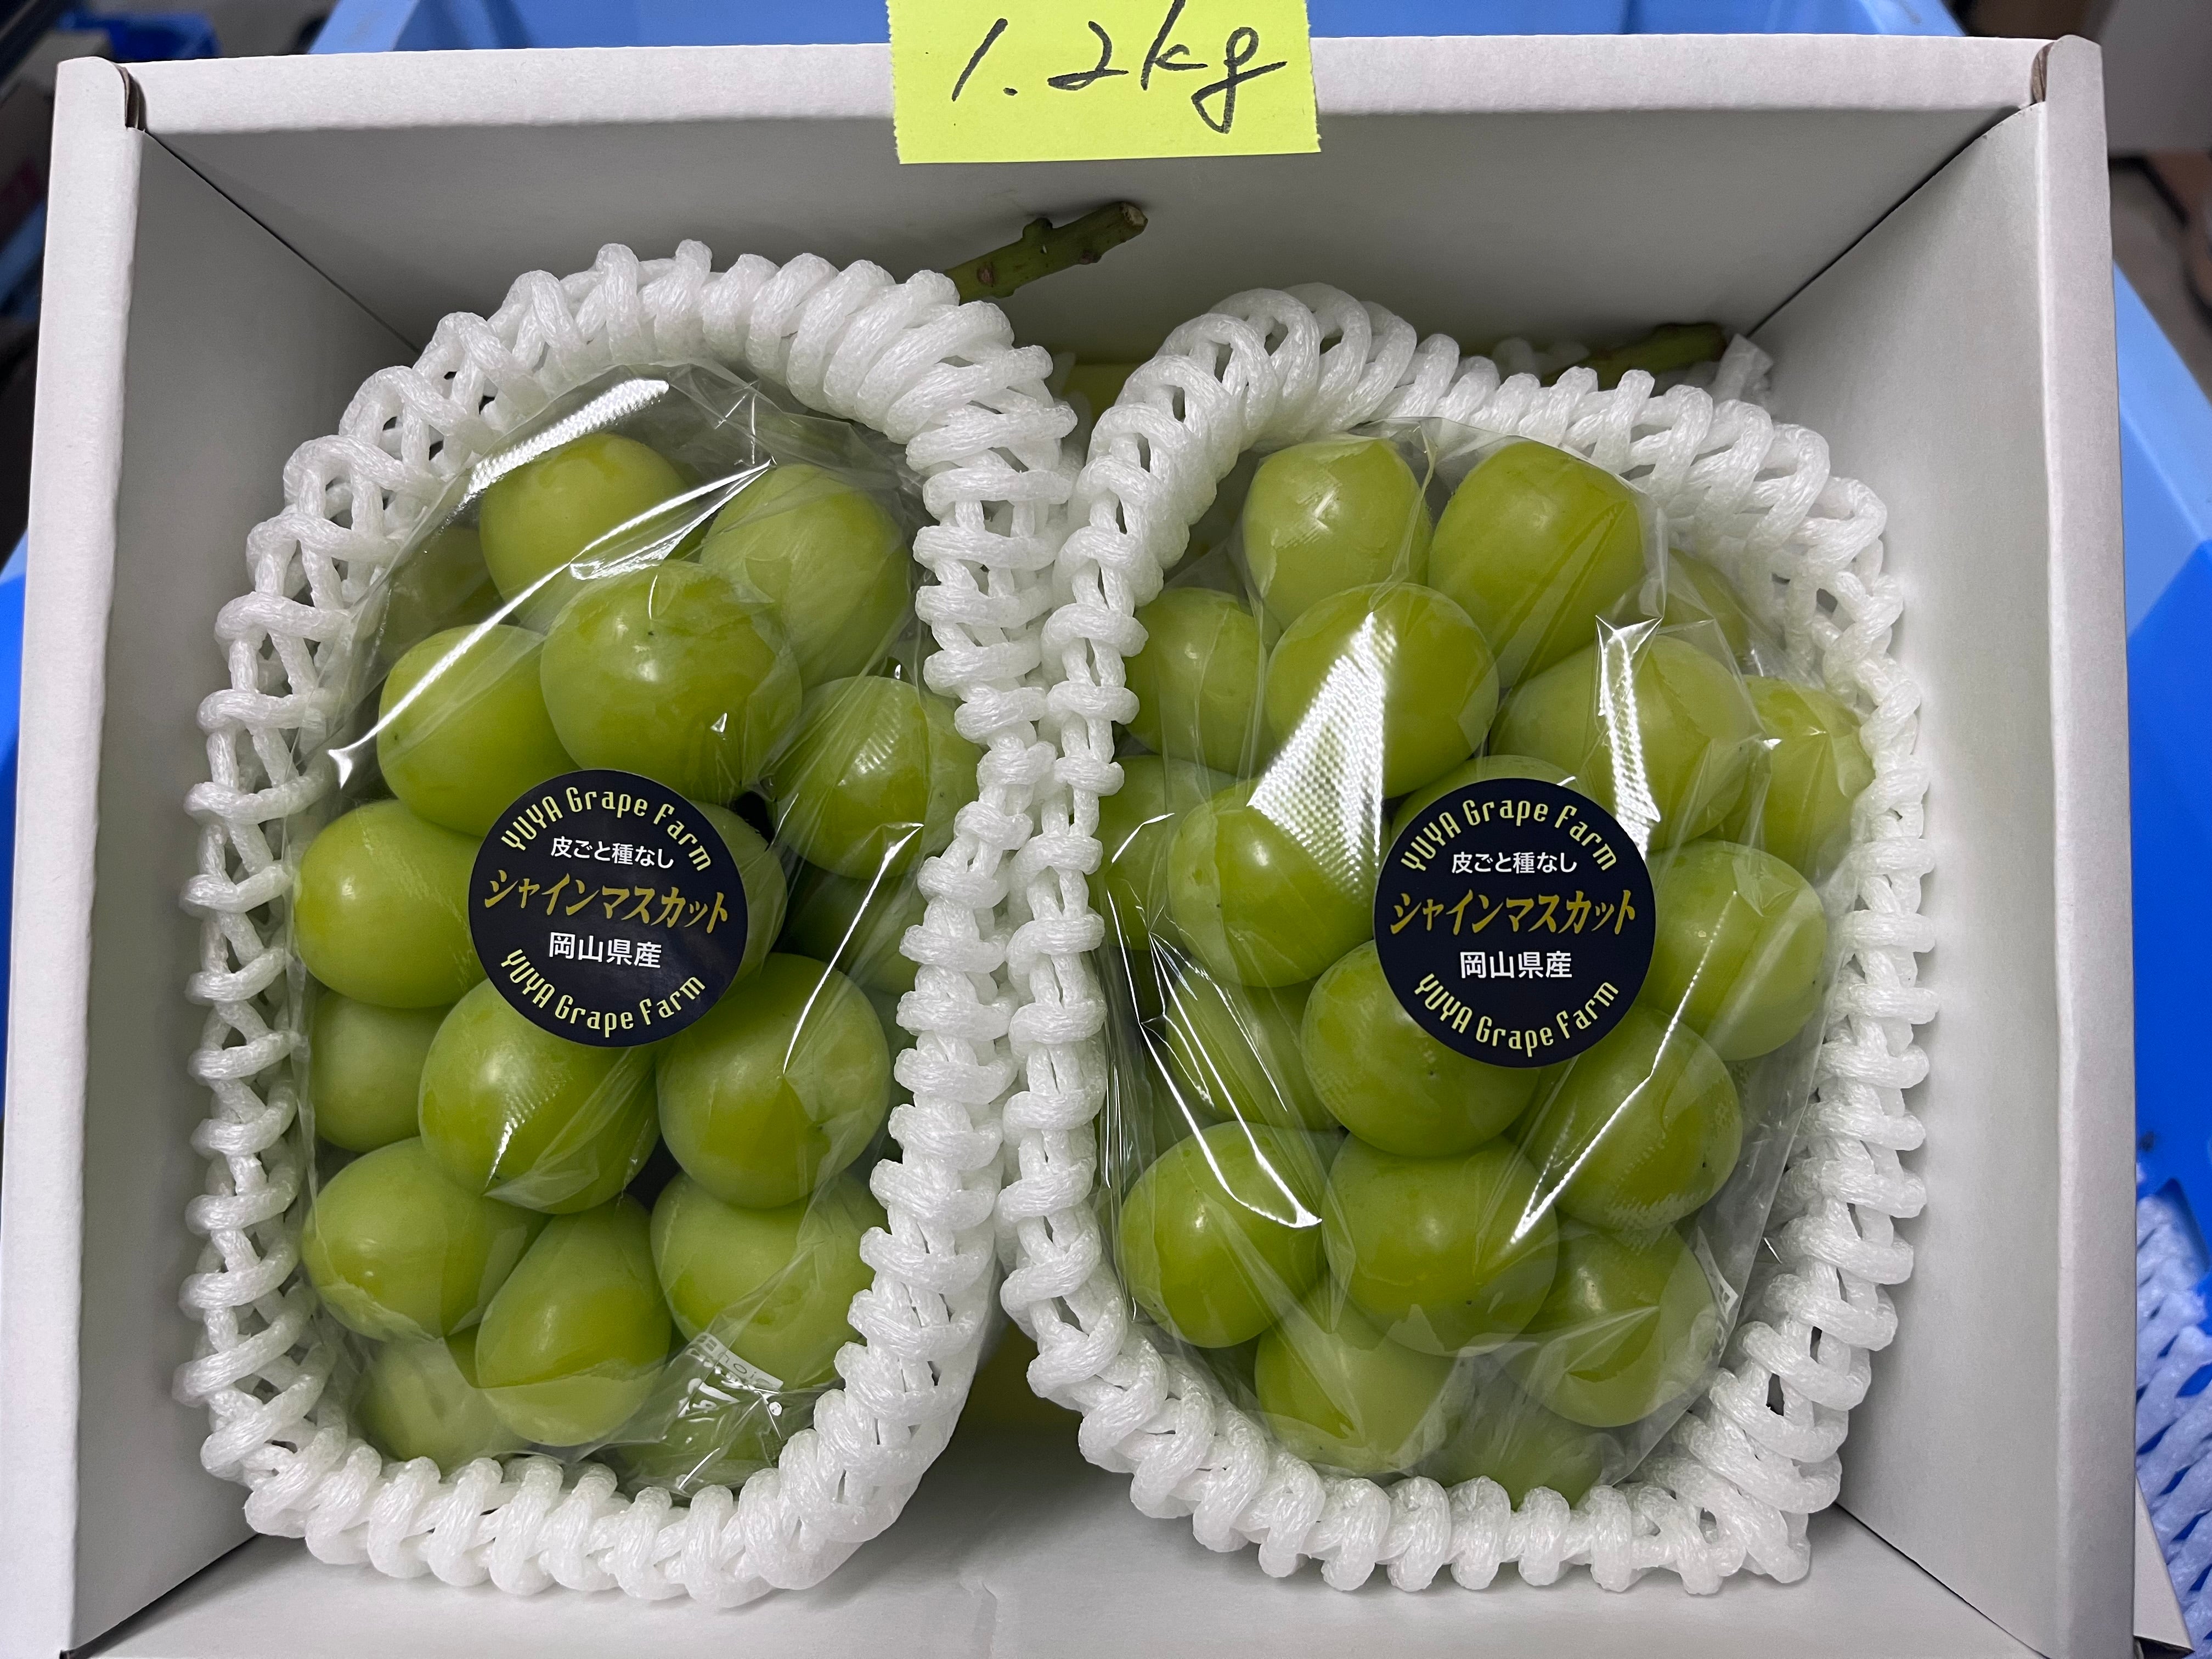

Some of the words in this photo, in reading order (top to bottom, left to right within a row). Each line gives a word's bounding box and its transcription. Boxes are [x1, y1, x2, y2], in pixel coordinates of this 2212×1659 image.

[952, 0, 1288, 134] 1.2kg
[501, 796, 562, 851] YUYA
[566, 787, 647, 818] Grape
[653, 803, 711, 871] Farm
[551, 836, 674, 868] 皮ごと種なし
[1401, 812, 1461, 871] YUYA
[1462, 799, 1548, 826] Grape
[1554, 805, 1616, 870] Farm
[1451, 851, 1577, 874] 皮ごと種なし
[484, 870, 728, 934] シャインマスカット
[1390, 889, 1635, 935] シャインマスカット
[549, 932, 662, 968] 岡山県産
[1460, 951, 1572, 979] 岡山県産
[501, 949, 555, 1008] YUYA
[555, 994, 634, 1037] Grape
[639, 976, 705, 1025] Farm
[1414, 973, 1472, 1033] YUYA
[1476, 1015, 1553, 1057] Grape
[1556, 982, 1618, 1039] Farm
